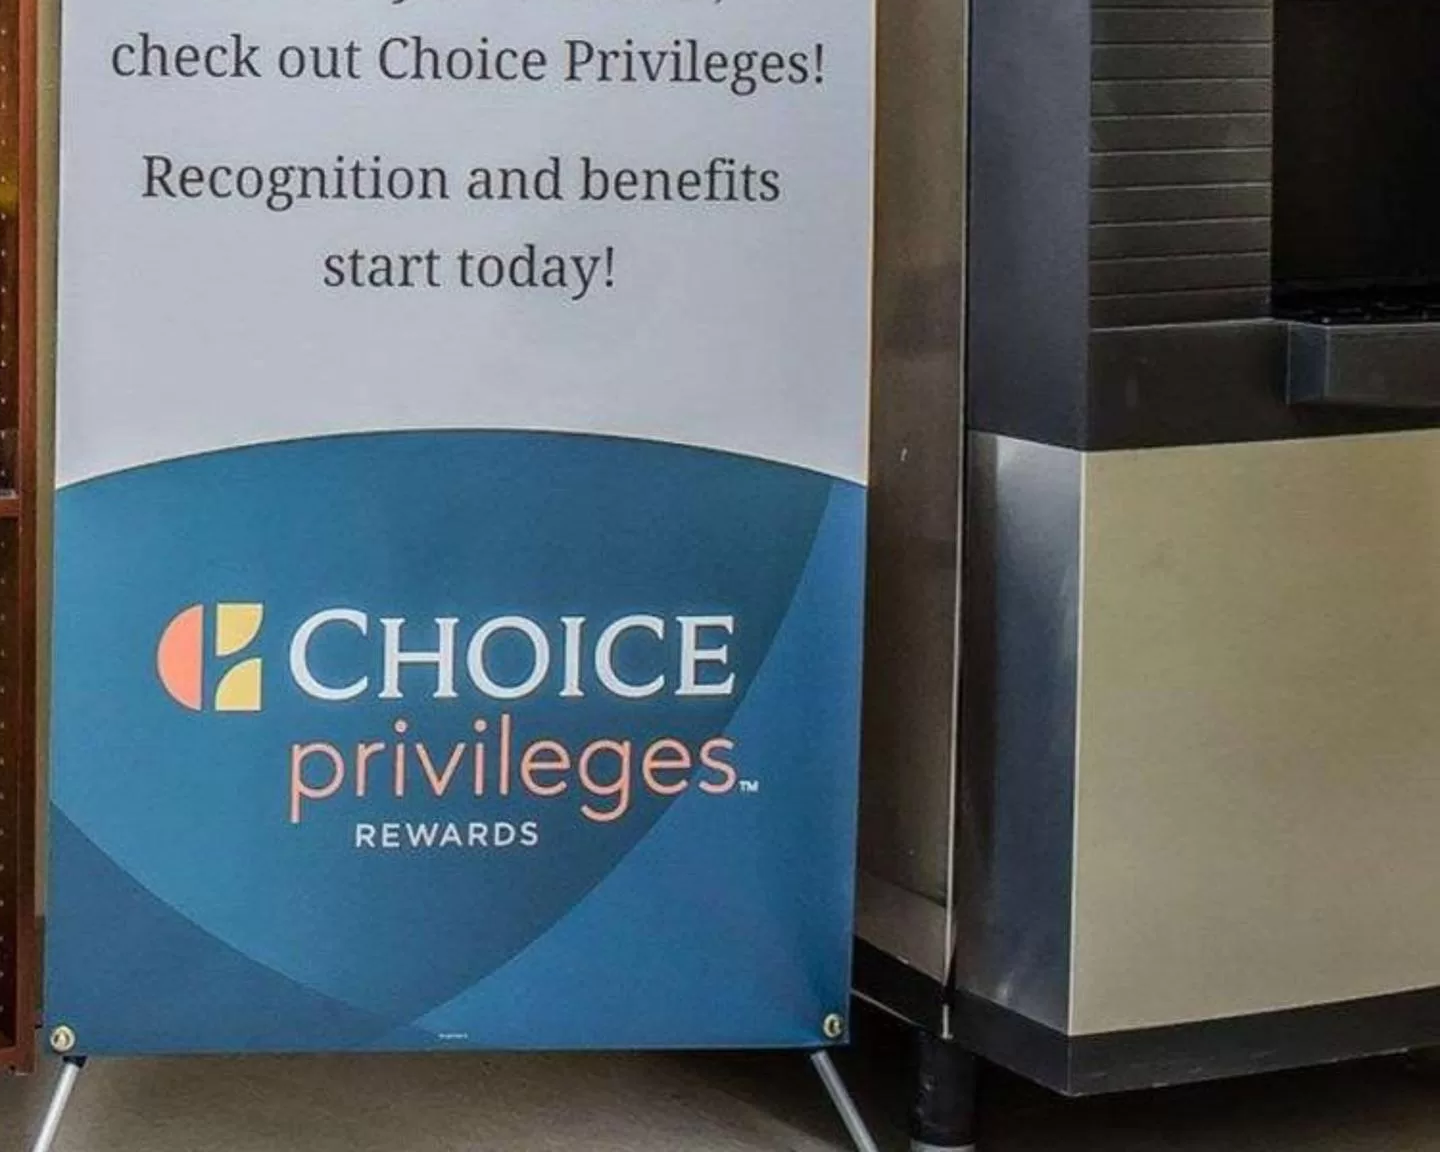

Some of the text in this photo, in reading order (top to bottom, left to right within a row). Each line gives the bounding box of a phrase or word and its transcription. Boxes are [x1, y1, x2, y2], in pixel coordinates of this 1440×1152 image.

[111, 32, 824, 96] check out Choice Privileges!
[142, 154, 781, 211] Recognition and benefits
[323, 244, 614, 300] start today!
[289, 608, 736, 700] CHOICE
[289, 714, 738, 823] privileges
[356, 821, 539, 848] REWARDS
